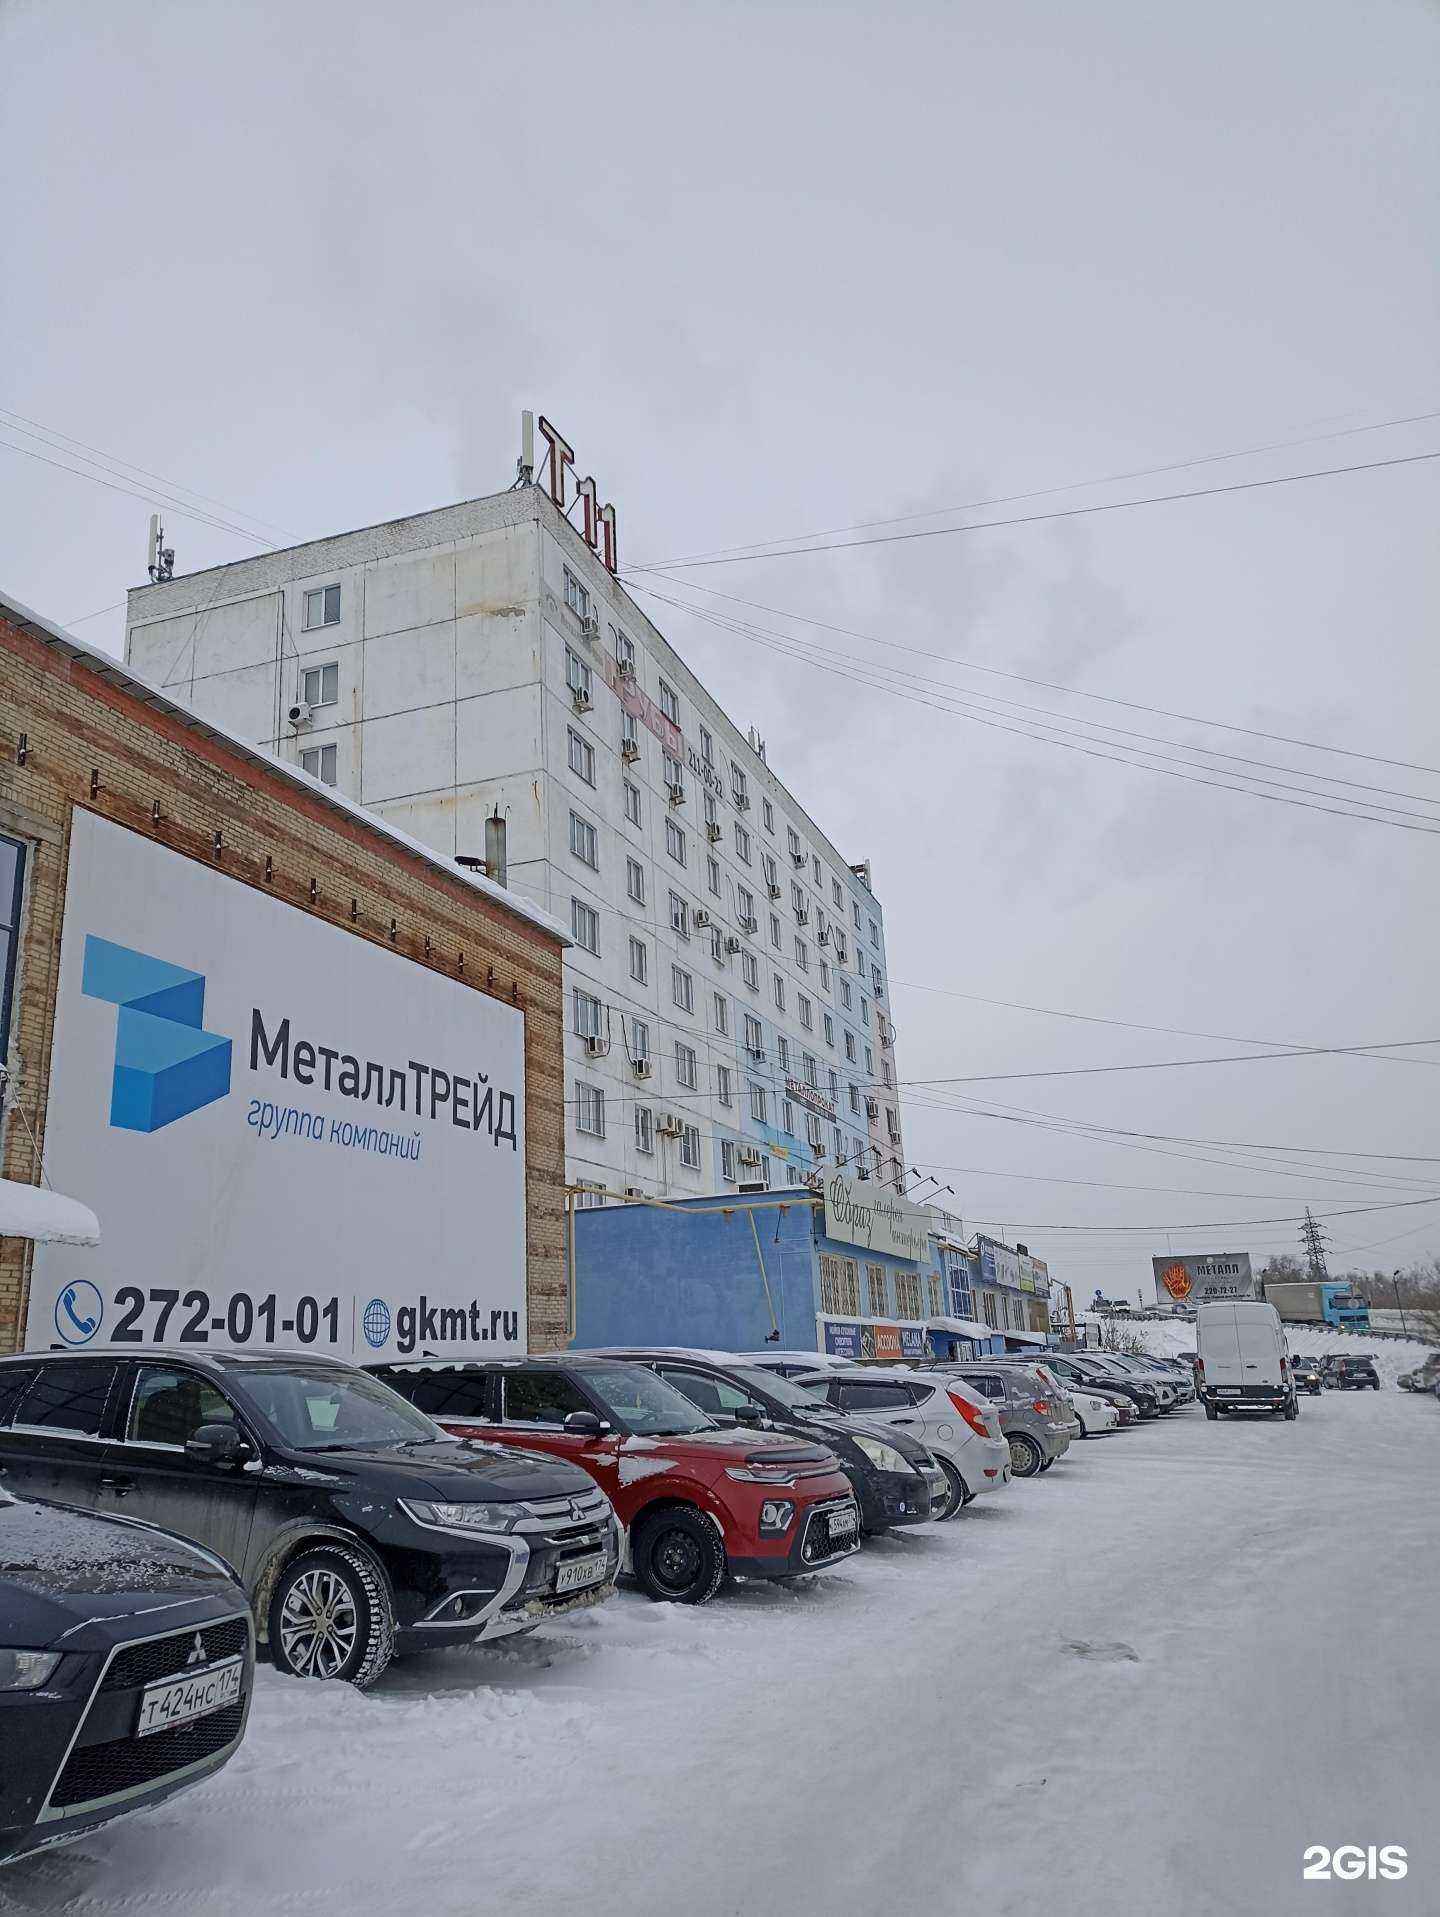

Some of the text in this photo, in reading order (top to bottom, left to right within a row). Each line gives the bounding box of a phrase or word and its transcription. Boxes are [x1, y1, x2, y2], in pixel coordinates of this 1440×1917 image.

[249, 1008, 517, 1151] МеталлТРЕЙД
[247, 1100, 422, 1161] группа компаний
[1197, 1264, 1239, 1275] МЕТАЛЛ
[111, 1287, 338, 1344] 272-01-01
[396, 1295, 519, 1352] gkmt.ru
[148, 1683, 215, 1723] Т424НС
[219, 1667, 239, 1691] 174
